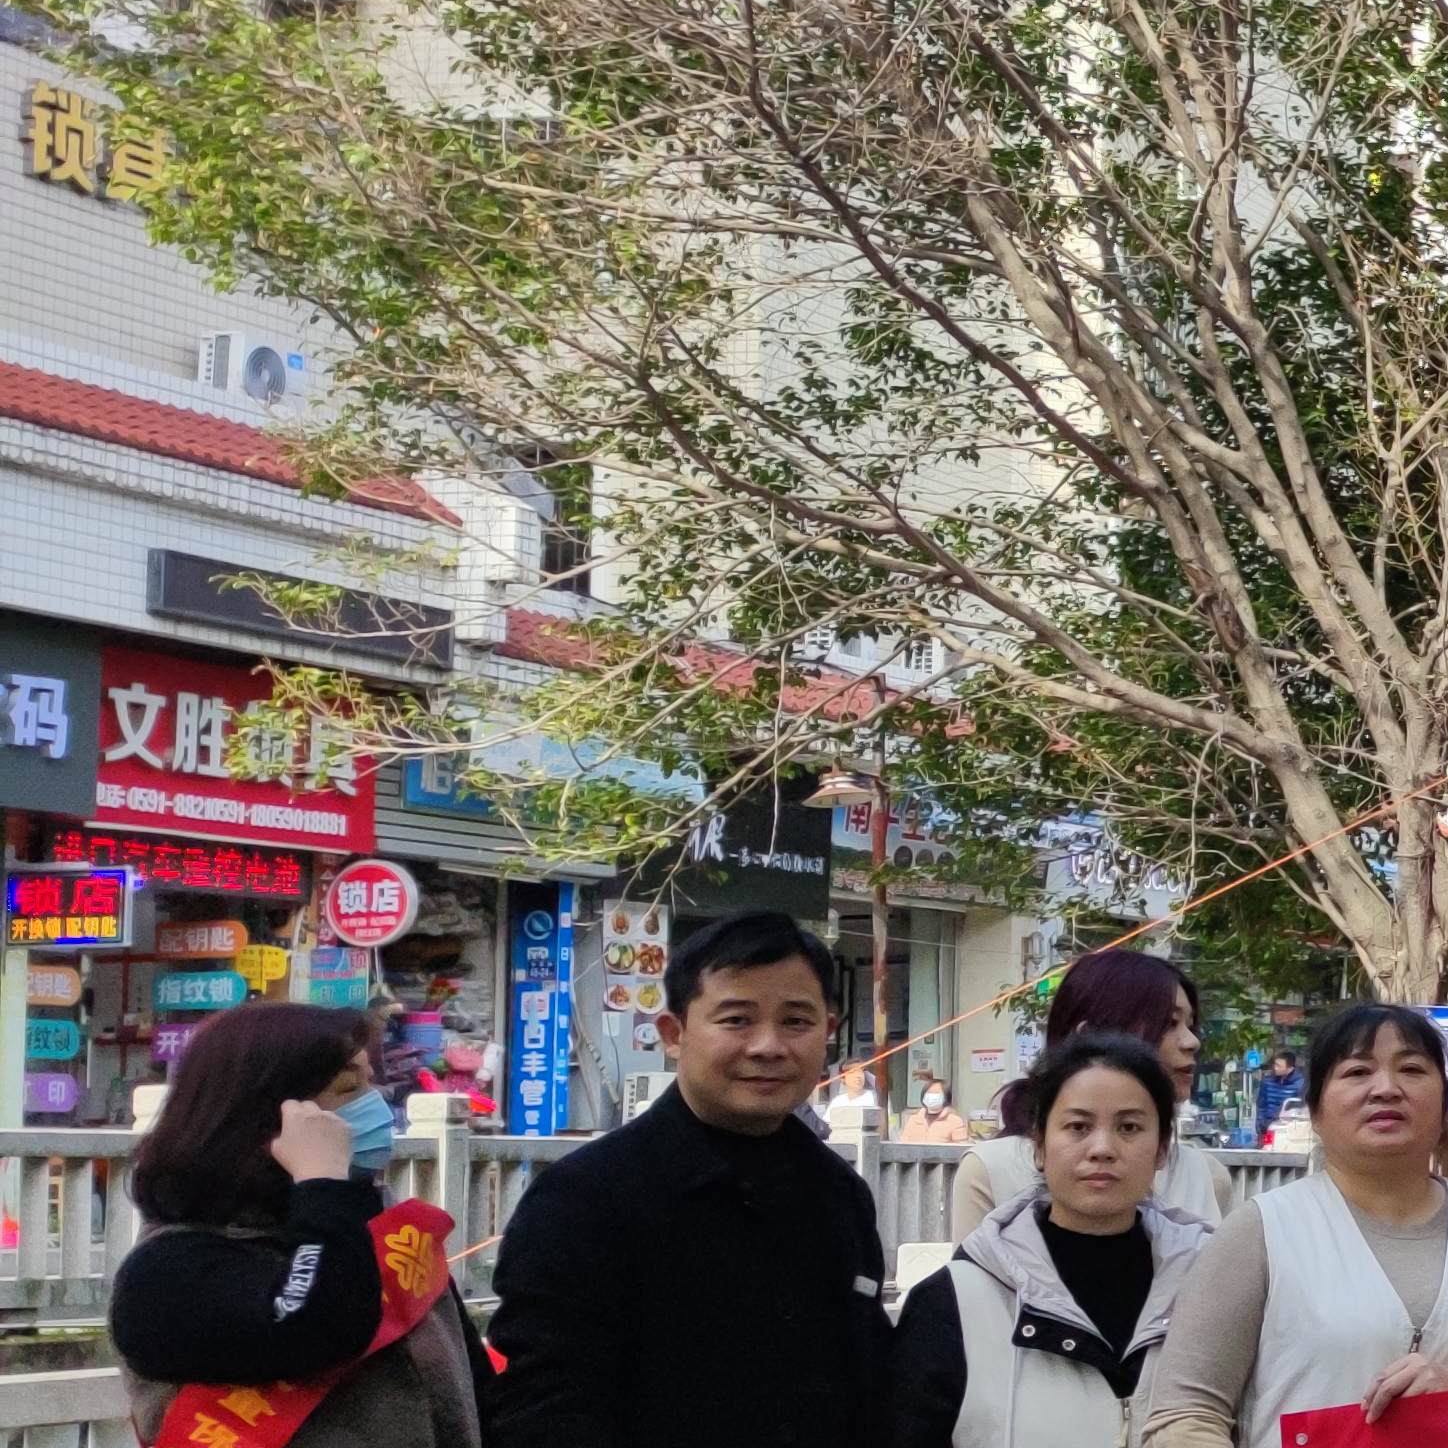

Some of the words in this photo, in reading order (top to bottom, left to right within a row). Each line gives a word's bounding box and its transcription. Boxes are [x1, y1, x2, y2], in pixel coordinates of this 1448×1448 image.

[0, 673, 68, 760] 码
[17, 876, 118, 914] 锁店
[338, 878, 401, 914] 锁店
[158, 977, 233, 1004] 指纹锁
[28, 1024, 71, 1052] 纹锁
[156, 1029, 192, 1057] 开
